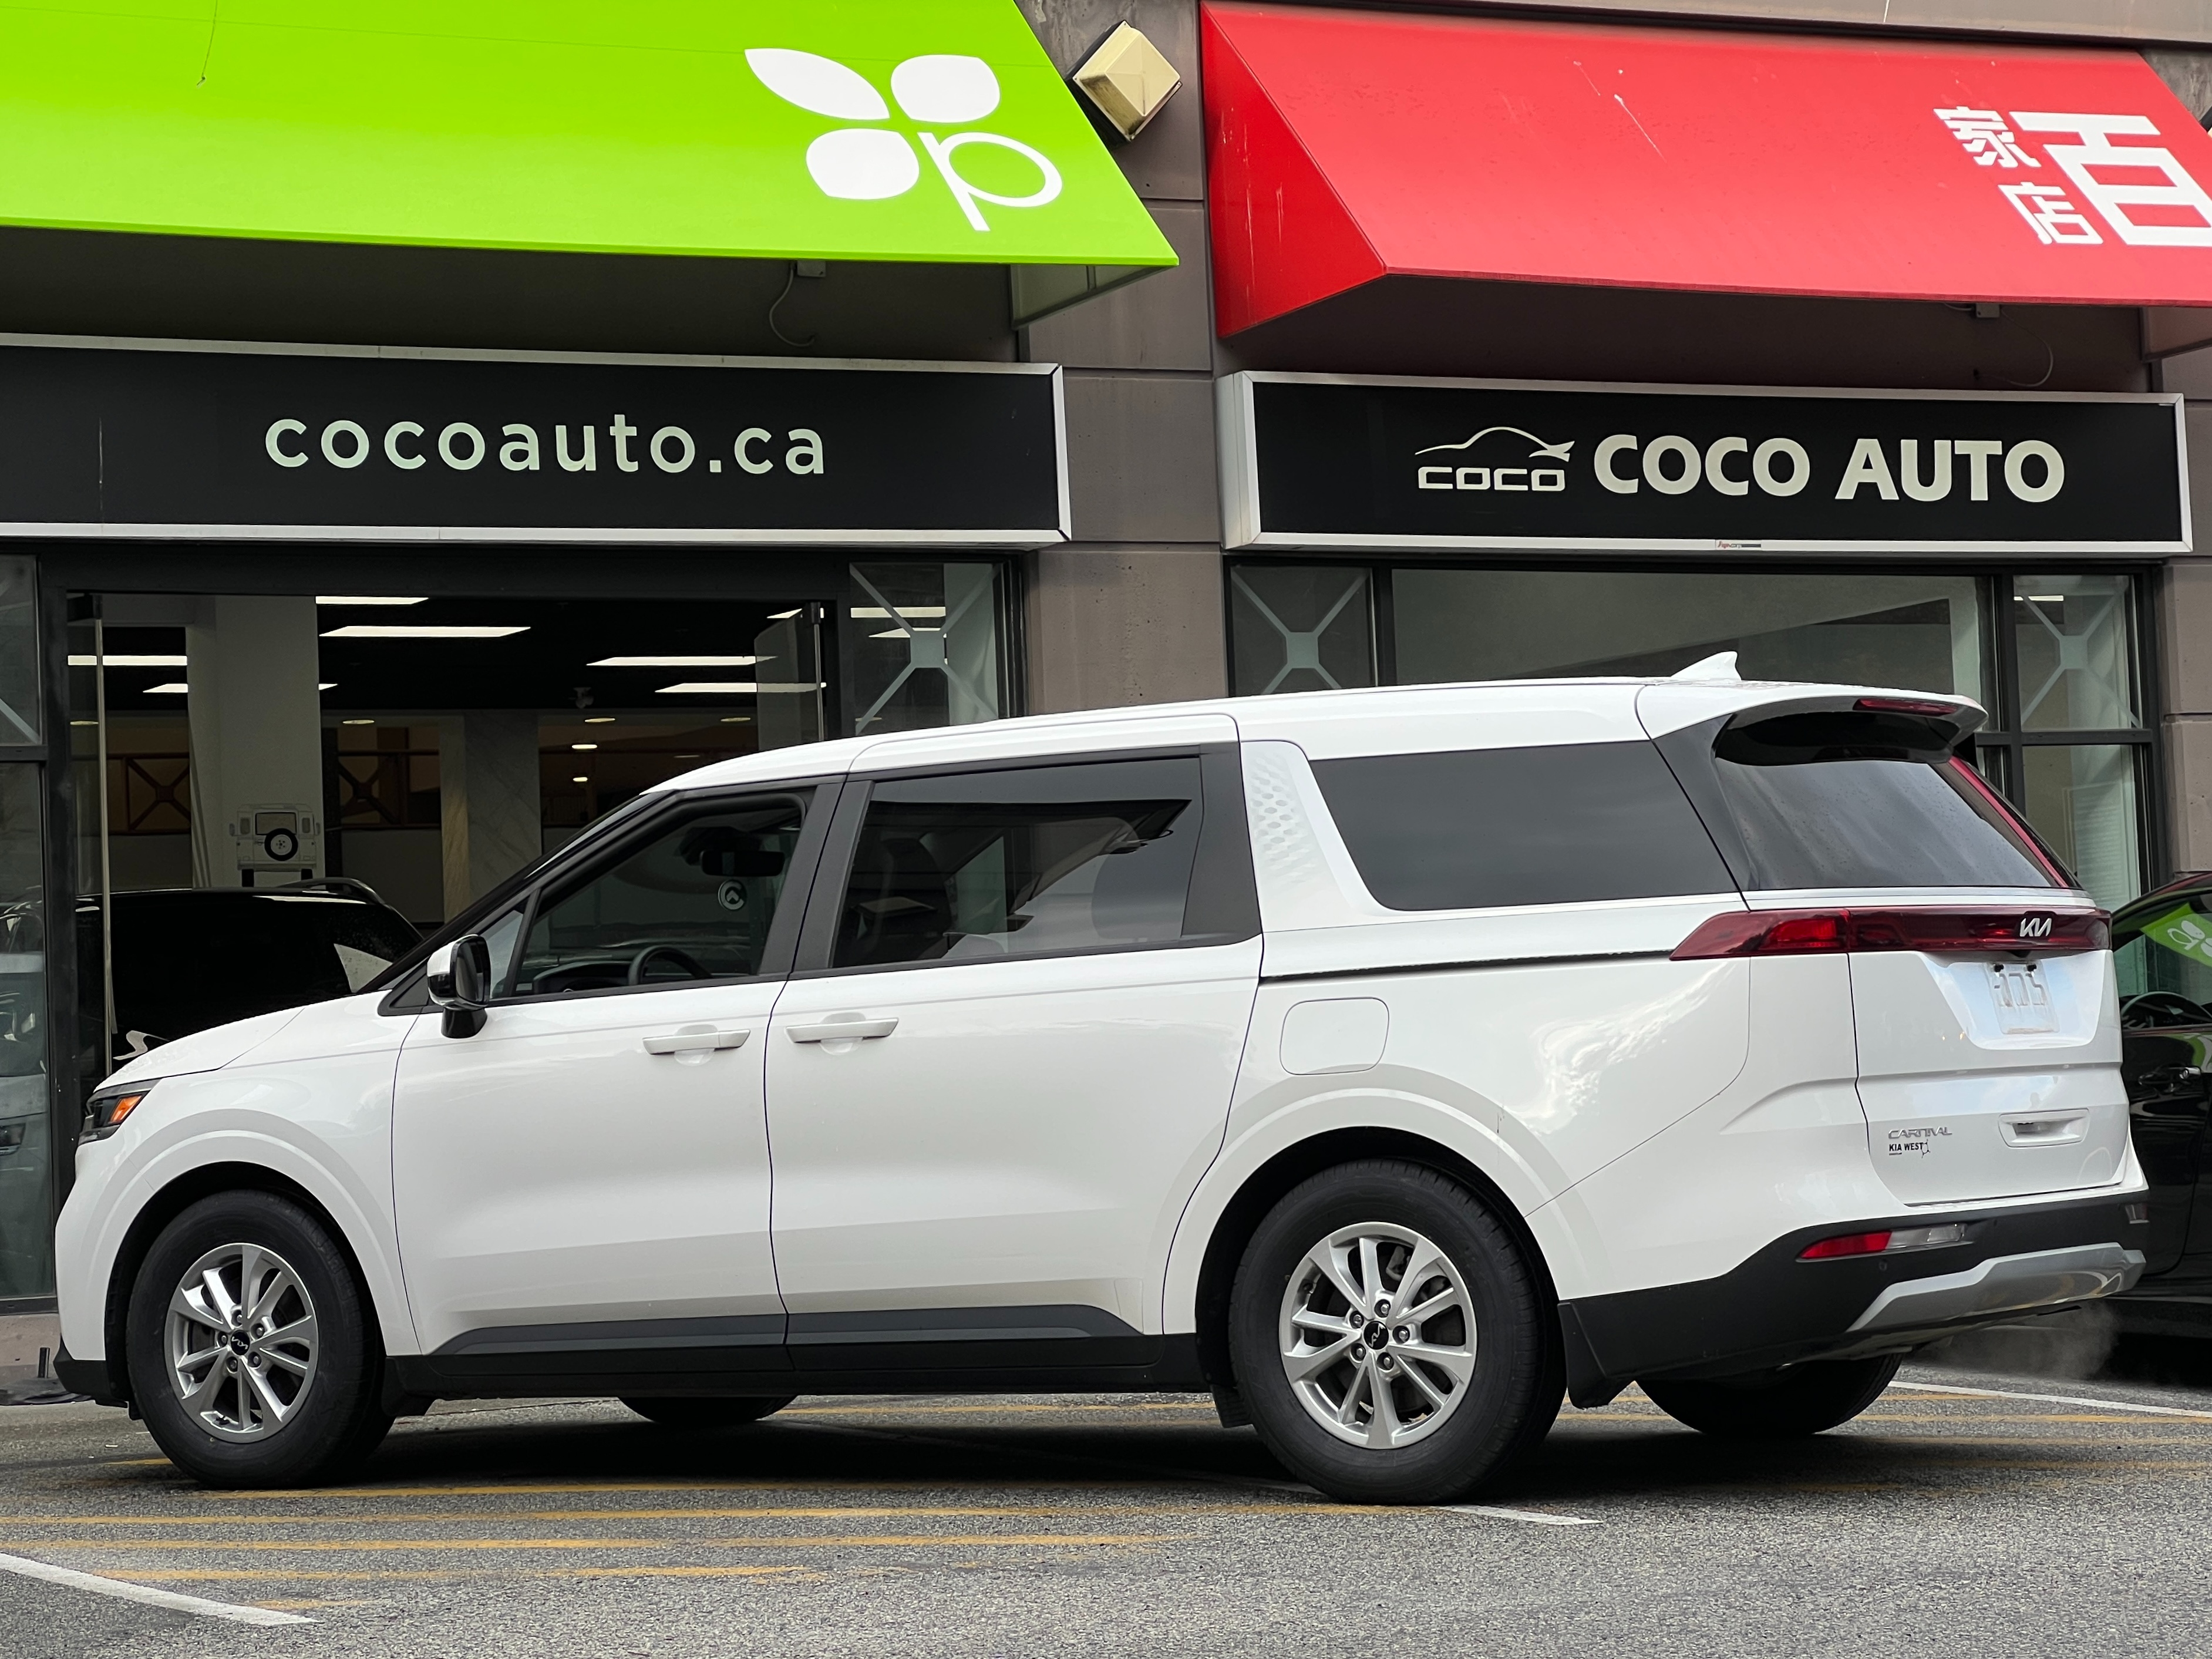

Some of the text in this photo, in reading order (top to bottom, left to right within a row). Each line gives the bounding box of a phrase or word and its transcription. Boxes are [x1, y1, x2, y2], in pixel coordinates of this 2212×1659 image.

[265, 414, 824, 475] cocoauto.ca
[1418, 466, 1565, 492] COCO
[1594, 434, 2065, 503] COCO AUTO
[1889, 1142, 1924, 1152] KIA WEST
